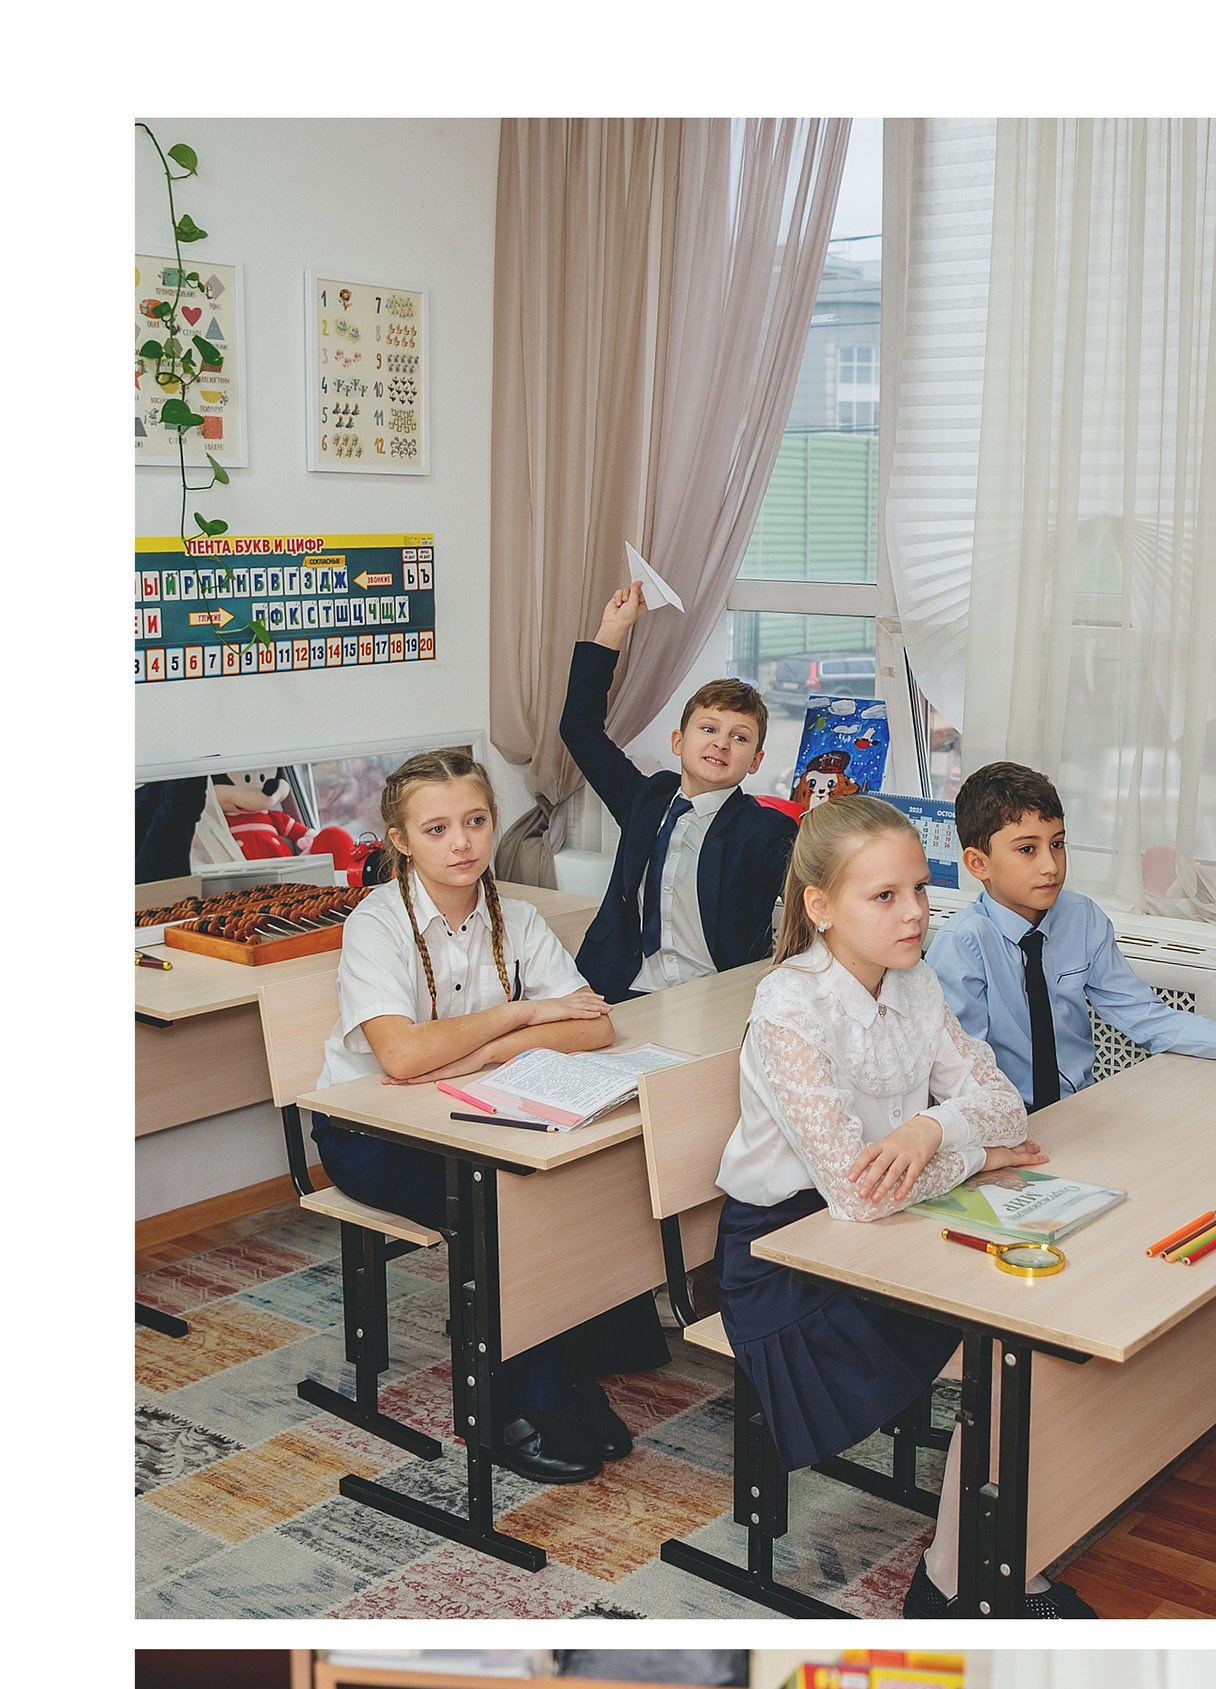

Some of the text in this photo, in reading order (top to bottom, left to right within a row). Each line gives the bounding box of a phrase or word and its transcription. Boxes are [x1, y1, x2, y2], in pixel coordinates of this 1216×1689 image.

[321, 290, 326, 307] 1
[376, 297, 381, 314] 7
[322, 319, 330, 336] 2
[376, 325, 380, 342] 8
[323, 348, 328, 364] 3
[376, 353, 382, 369] 9
[322, 376, 327, 393] 4
[374, 381, 384, 398] 10
[322, 407, 328, 423] 5
[374, 410, 383, 426] 11
[322, 434, 327, 451] 6
[374, 437, 386, 454] 12
[187, 538, 324, 554] ЛЕНТА БУКВ И ЦИФР
[144, 578, 158, 596] Ы
[166, 573, 176, 595] Й
[184, 576, 194, 594] Р
[237, 574, 246, 592] Н
[254, 574, 264, 592] Б
[272, 573, 281, 591] В
[289, 573, 296, 590] Г
[304, 572, 312, 590] З
[320, 572, 331, 592] Д
[334, 571, 347, 589] Ж
[367, 576, 391, 584] ЗВОНКИЕ
[408, 569, 430, 584] Ь Ъ
[271, 608, 283, 625] Ф
[290, 607, 299, 625] К
[308, 607, 315, 624] С
[323, 606, 331, 623] Т
[336, 605, 348, 622] Ш
[353, 604, 363, 623] Ц
[369, 603, 376, 620] Ч
[382, 602, 393, 622] Щ
[398, 602, 406, 618] Х
[148, 615, 157, 633] И
[151, 658, 159, 672] 4
[171, 656, 179, 670] 5
[190, 655, 197, 670] 6
[209, 654, 216, 668] 7
[227, 653, 234, 667] 8
[245, 652, 252, 666] 9
[260, 650, 272, 664] 10
[279, 648, 290, 662] 11
[295, 648, 308, 661] 12
[312, 646, 324, 660] 13
[328, 645, 340, 658] 14
[344, 643, 356, 657] 15
[360, 642, 372, 656] 16
[376, 641, 387, 655] 17
[391, 640, 402, 654] 18
[406, 639, 417, 652] 19
[420, 638, 432, 652] 20
[909, 806, 922, 814] 2025
